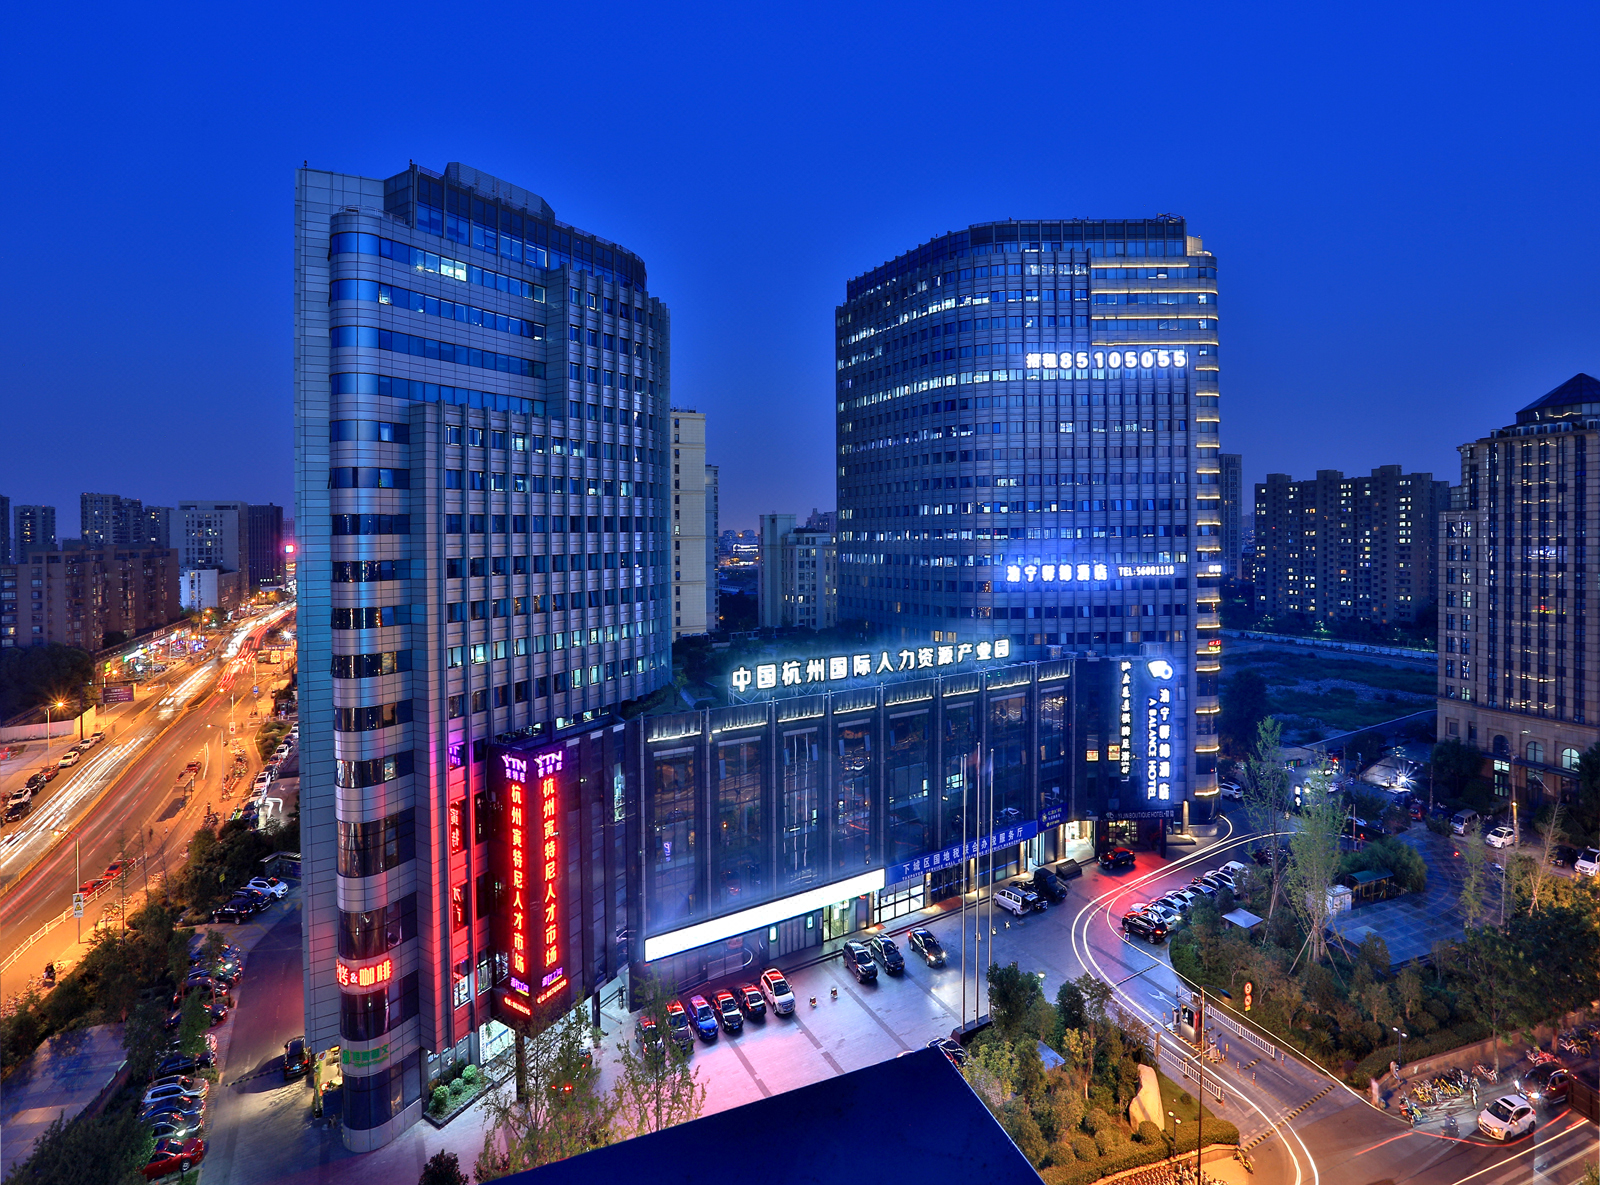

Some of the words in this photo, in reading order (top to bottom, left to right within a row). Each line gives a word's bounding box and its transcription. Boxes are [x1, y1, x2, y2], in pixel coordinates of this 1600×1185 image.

[732, 639, 1010, 693] 中国杭州国际人力资源产业园
[1148, 698, 1157, 706] A
[1148, 709, 1157, 757] BALANCE
[501, 754, 527, 772] YTN
[534, 751, 562, 768] YTN
[1148, 761, 1157, 799] HOTEL
[542, 778, 558, 967] 杭州寅特尼人才市场
[902, 826, 1024, 875] 下城区国地税联合办税服务厅
[511, 784, 525, 974] 杭州寅特尼人才市场
